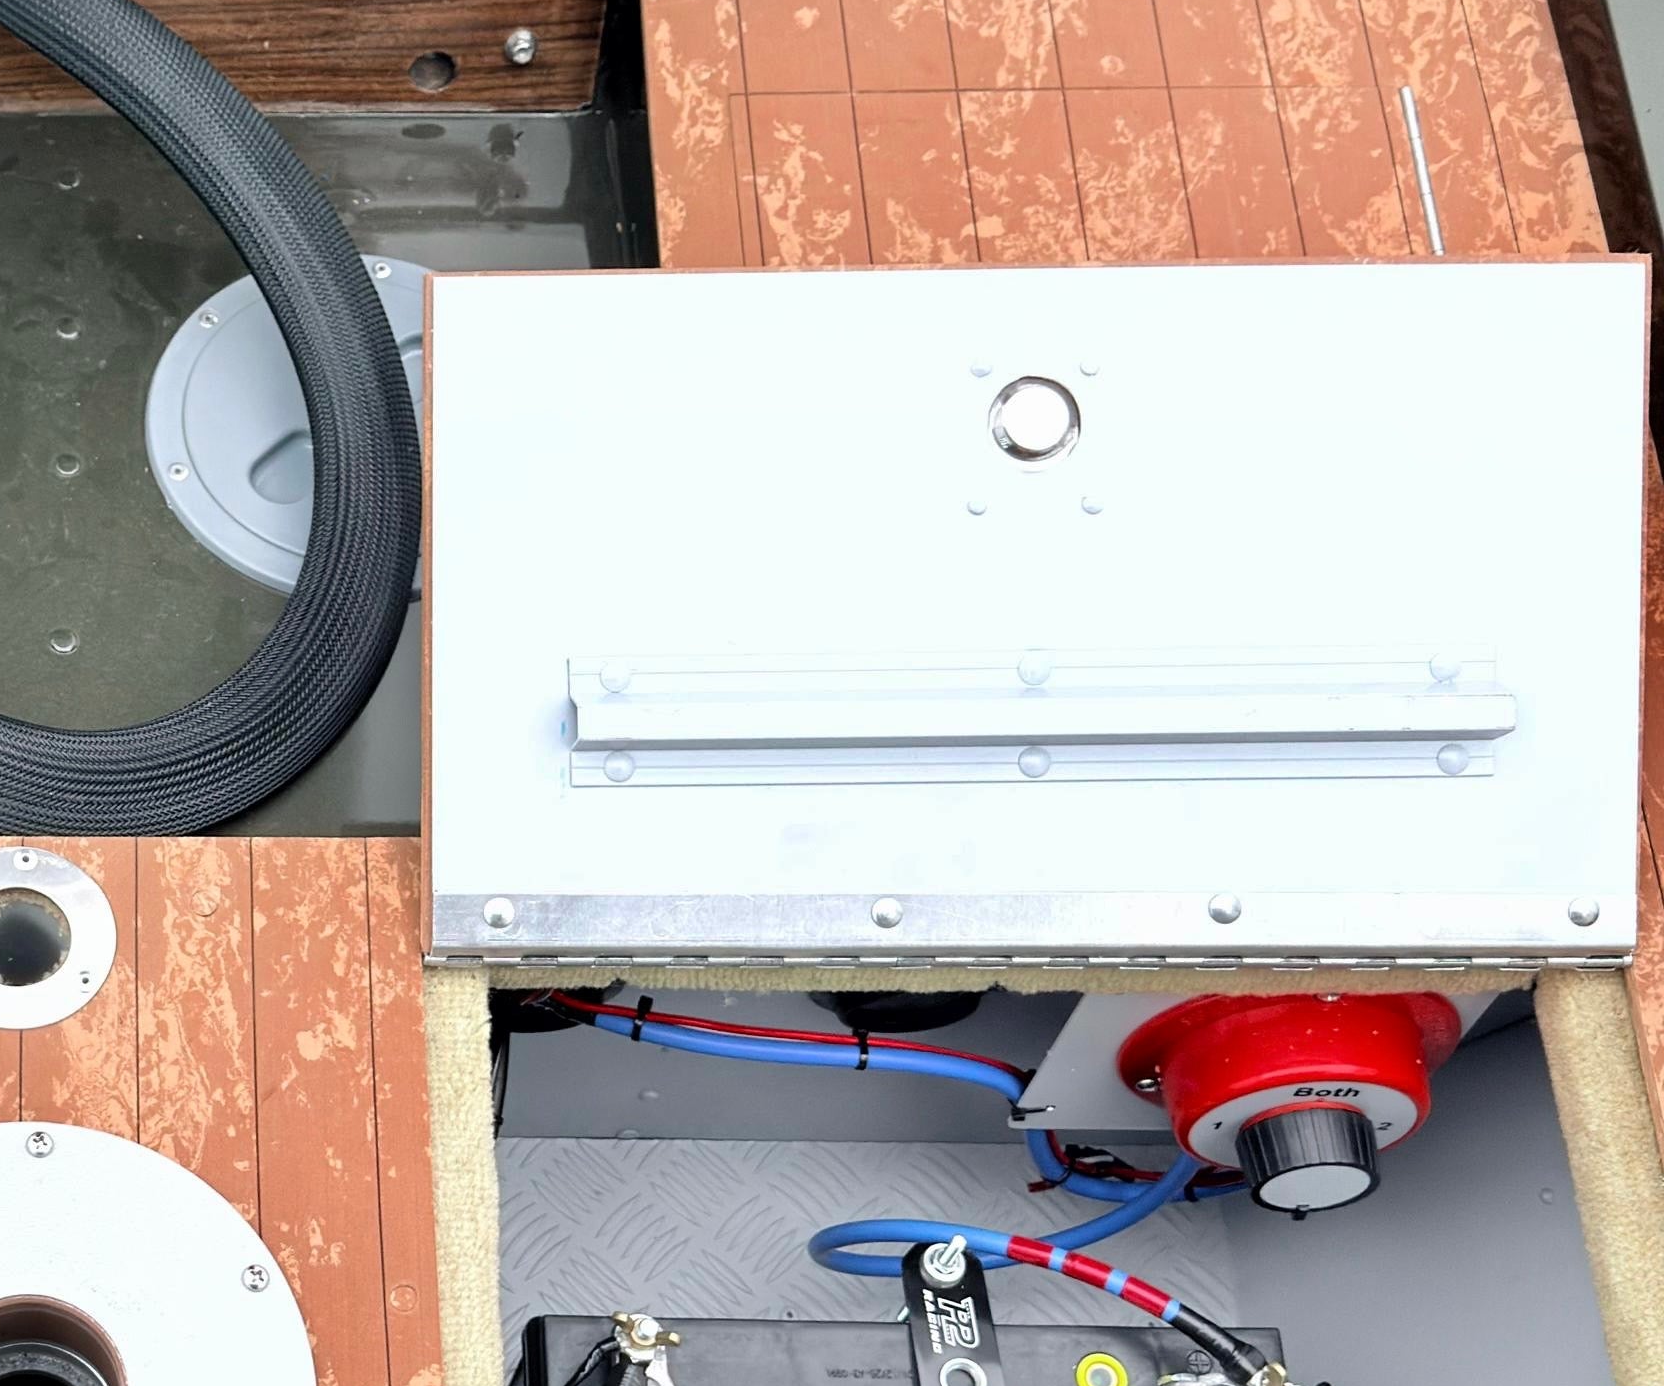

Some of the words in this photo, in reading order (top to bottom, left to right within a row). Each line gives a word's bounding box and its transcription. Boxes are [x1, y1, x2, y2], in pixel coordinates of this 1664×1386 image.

[1293, 1087, 1360, 1098] Both
[1212, 1121, 1223, 1130] 1
[1377, 1122, 1393, 1131] 2
[923, 1289, 943, 1354] RACING
